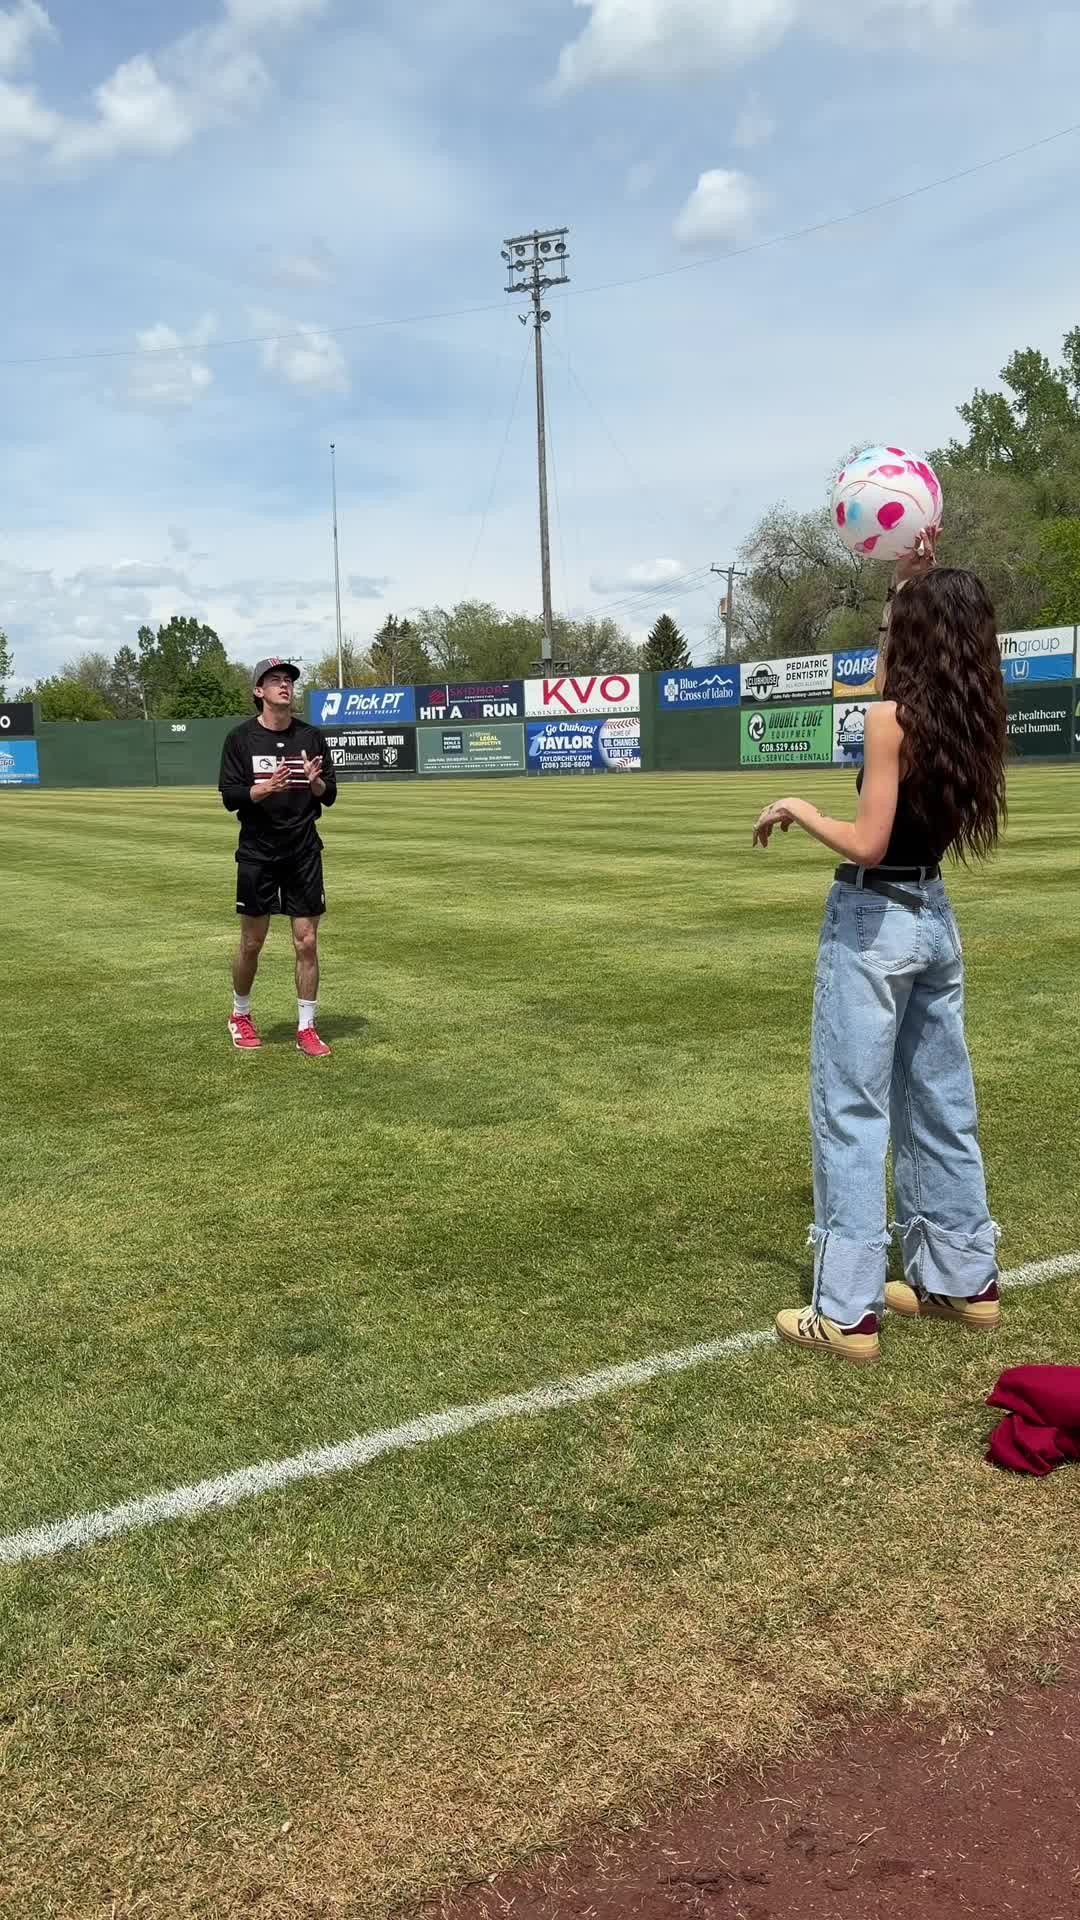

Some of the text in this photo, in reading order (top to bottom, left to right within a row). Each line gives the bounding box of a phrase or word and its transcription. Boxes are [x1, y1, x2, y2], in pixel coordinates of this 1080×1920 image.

[786, 659, 828, 670] PEDIATRIC
[786, 669, 829, 681] DENTISTRY
[680, 678, 698, 689] Blue
[543, 676, 630, 713] KVO
[680, 687, 734, 701] Cross of Idaho
[346, 693, 405, 710] Pick PT
[420, 706, 462, 720] HIT A
[483, 703, 518, 718] RUN
[1018, 710, 1067, 721] healthcare
[769, 710, 823, 729] DOUBLE EDGE
[171, 724, 187, 732] 390
[545, 722, 598, 736] Go Chukars!
[1011, 723, 1028, 734] feel
[1028, 723, 1062, 734] human.
[771, 729, 817, 740] EQUIPMENT
[339, 737, 348, 746] UP
[348, 736, 356, 746] TO
[357, 736, 368, 746] THE
[369, 735, 386, 746] PLATE
[387, 735, 404, 745] WITH
[539, 735, 594, 750] TAYLOR
[610, 748, 632, 757] FOR LIFE
[761, 742, 808, 752] 208.529.6653
[800, 753, 830, 761] RENTALS
